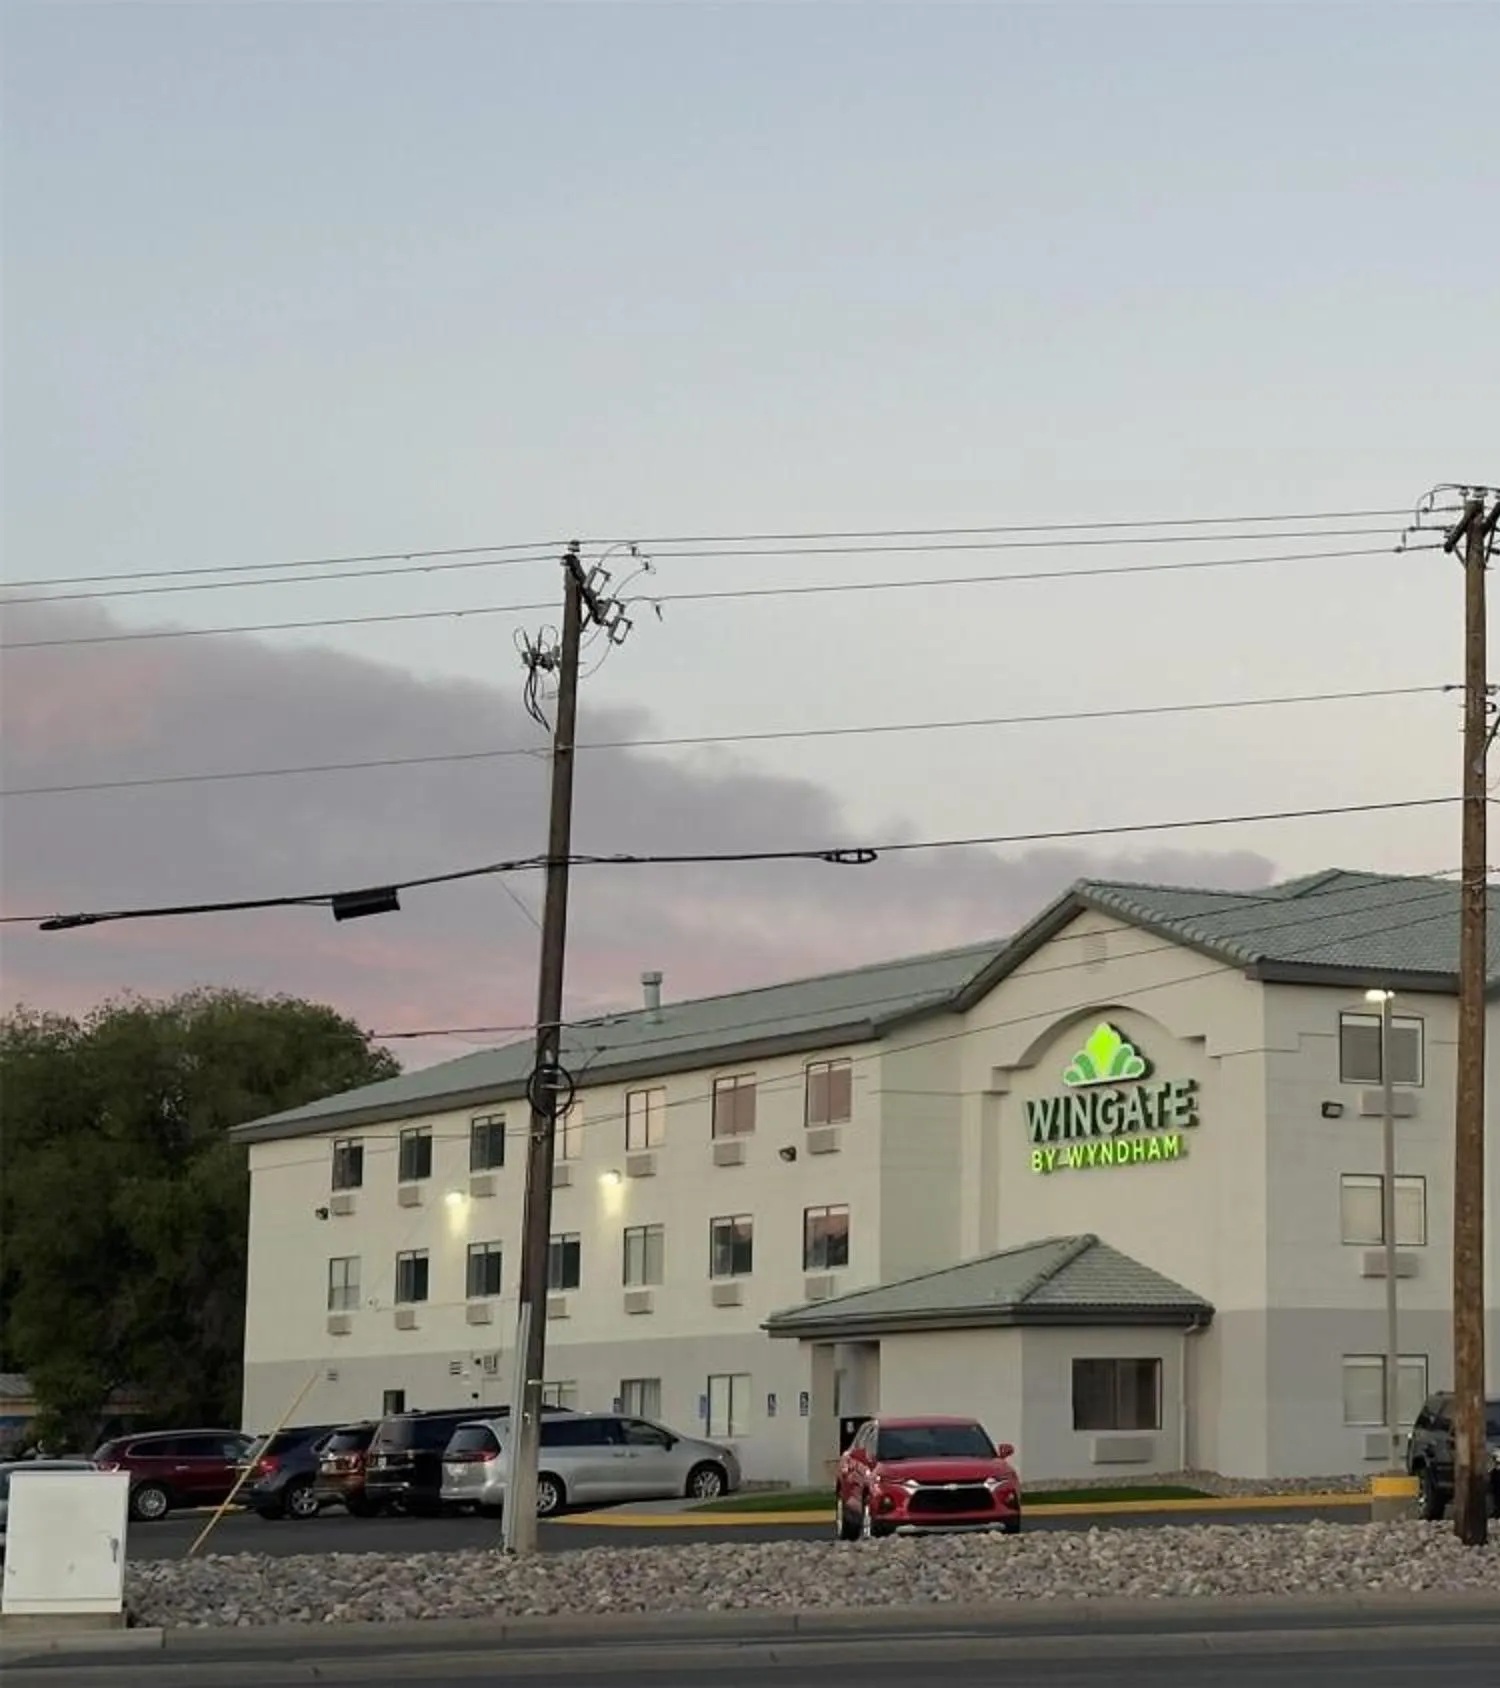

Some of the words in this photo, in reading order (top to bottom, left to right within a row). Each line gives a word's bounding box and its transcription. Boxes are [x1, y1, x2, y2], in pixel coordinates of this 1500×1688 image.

[1024, 1079, 1199, 1142] WINGATE
[1031, 1149, 1058, 1173] BY
[1066, 1135, 1182, 1169] WYNDHAM
